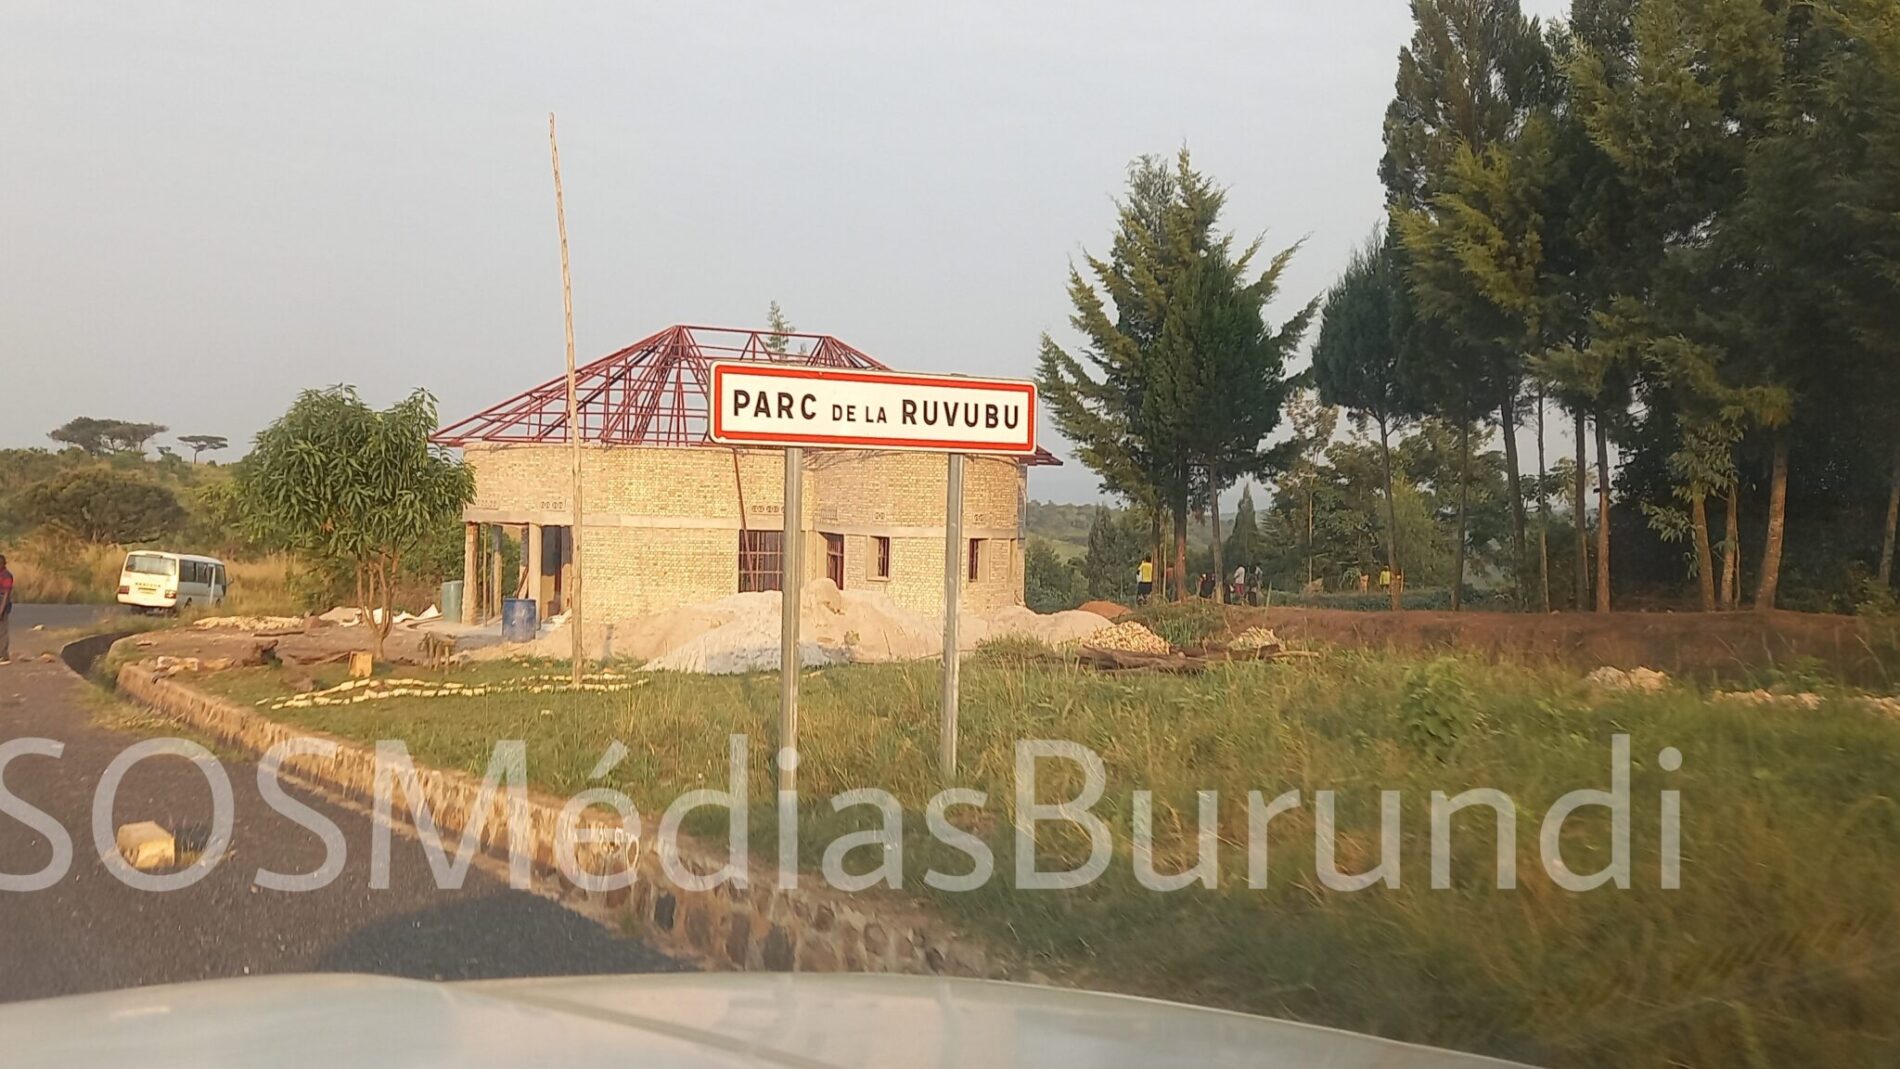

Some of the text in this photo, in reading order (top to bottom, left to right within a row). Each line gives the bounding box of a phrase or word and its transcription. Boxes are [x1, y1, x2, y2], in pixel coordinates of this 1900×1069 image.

[733, 389, 1019, 429] PARC DE LA RUVUBU
